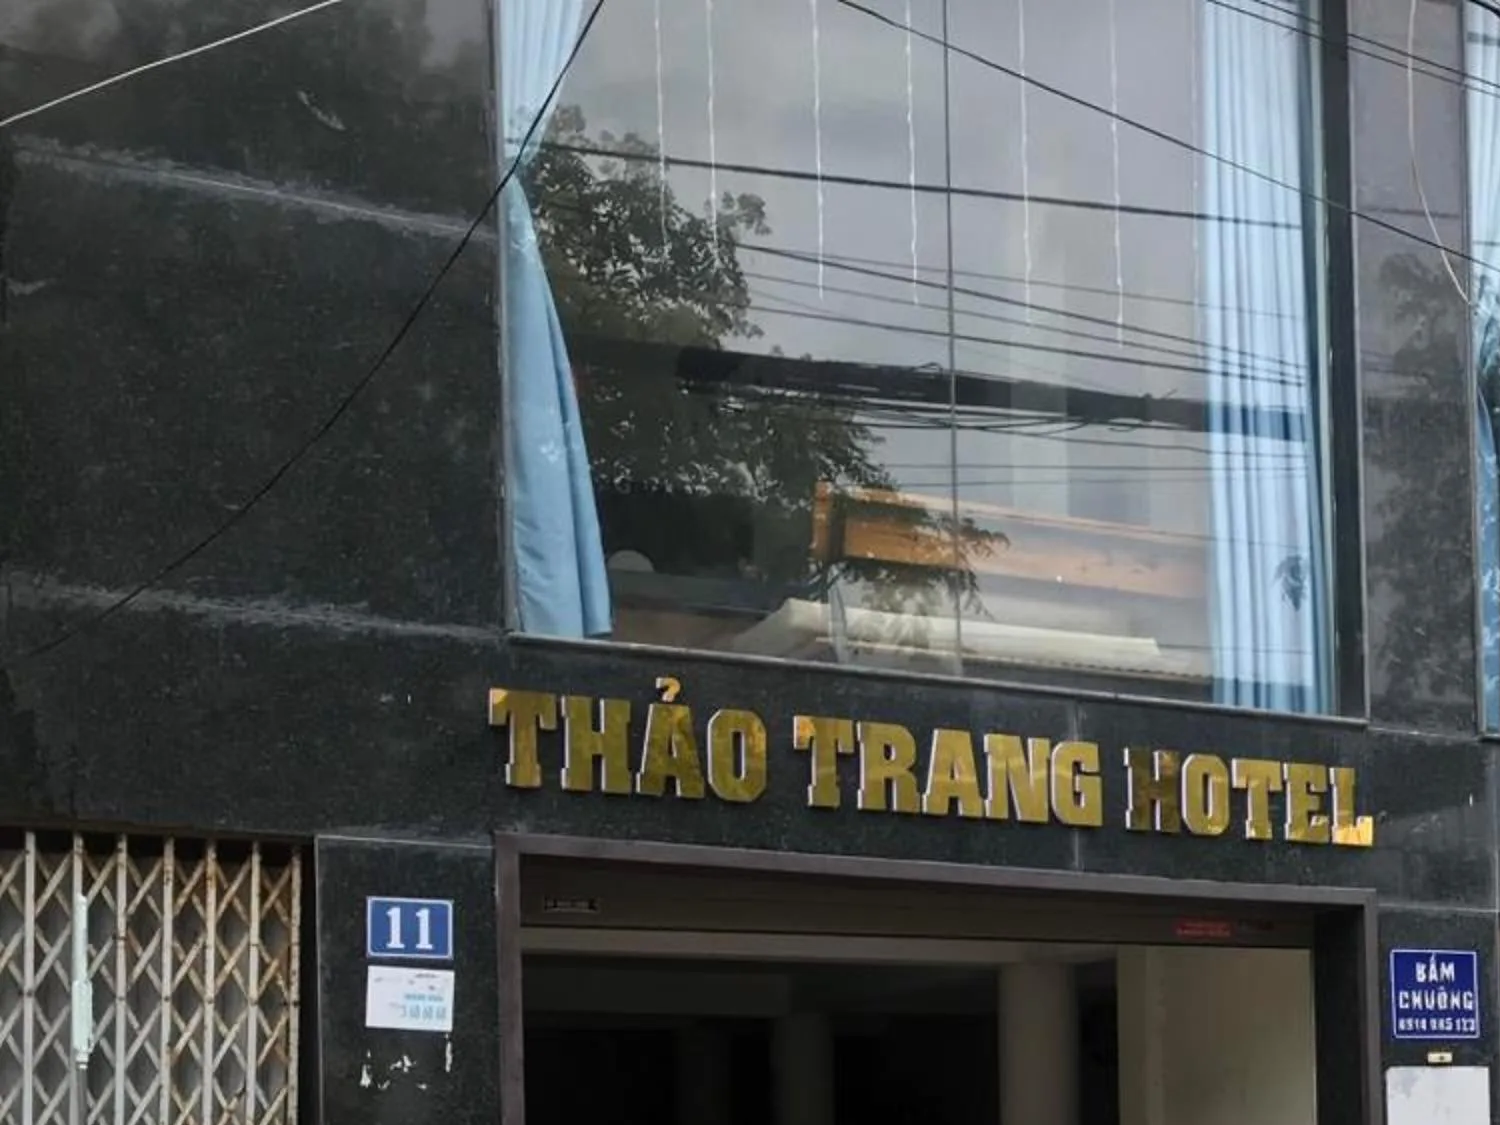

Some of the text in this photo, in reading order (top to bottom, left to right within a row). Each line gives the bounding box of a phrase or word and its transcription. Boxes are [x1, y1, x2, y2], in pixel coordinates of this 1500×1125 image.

[489, 677, 1374, 847] THẢO TRANG HOTEL
[386, 907, 434, 949] 11
[1415, 954, 1455, 983] BẤM
[1399, 986, 1473, 1011] CHUÔNG
